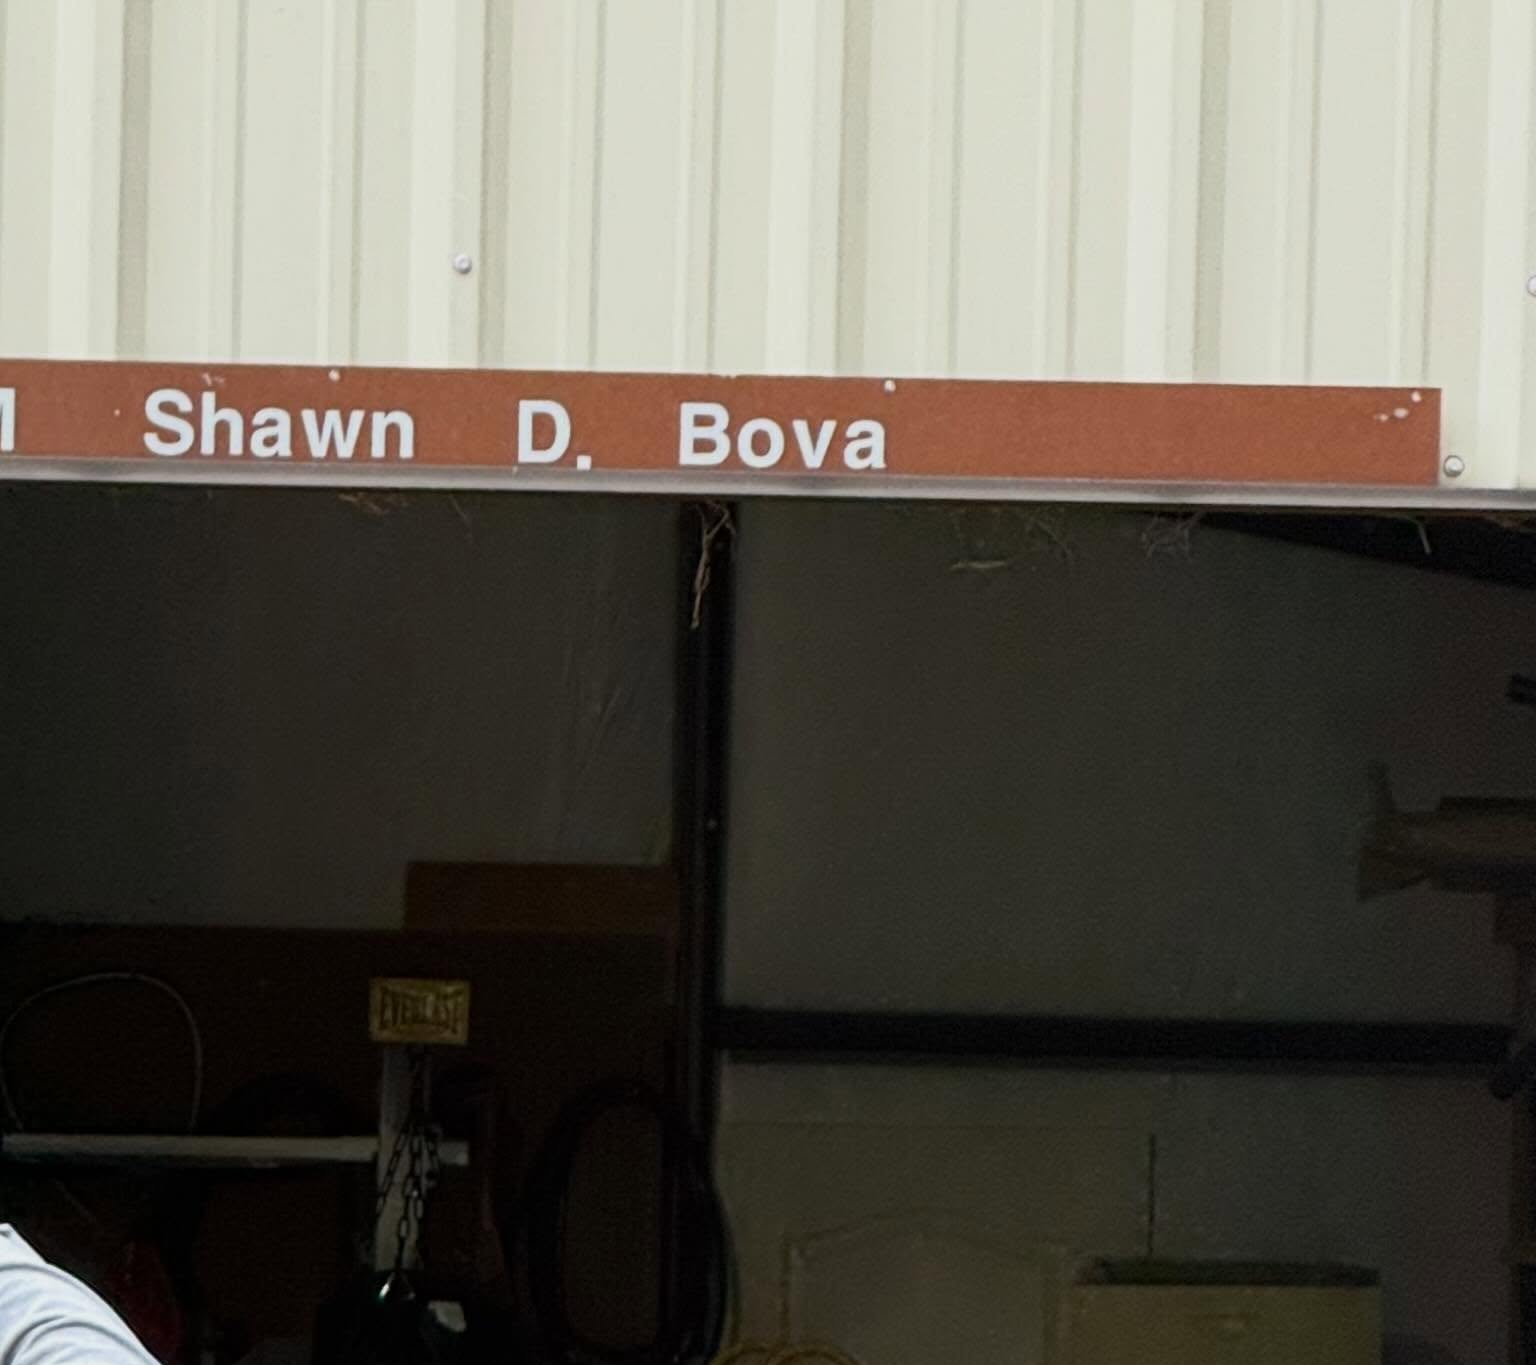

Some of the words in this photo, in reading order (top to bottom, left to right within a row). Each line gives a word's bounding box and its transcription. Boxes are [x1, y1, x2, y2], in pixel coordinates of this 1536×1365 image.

[143, 388, 415, 459] Shawn
[517, 400, 592, 470] D.
[679, 402, 888, 471] Bova
